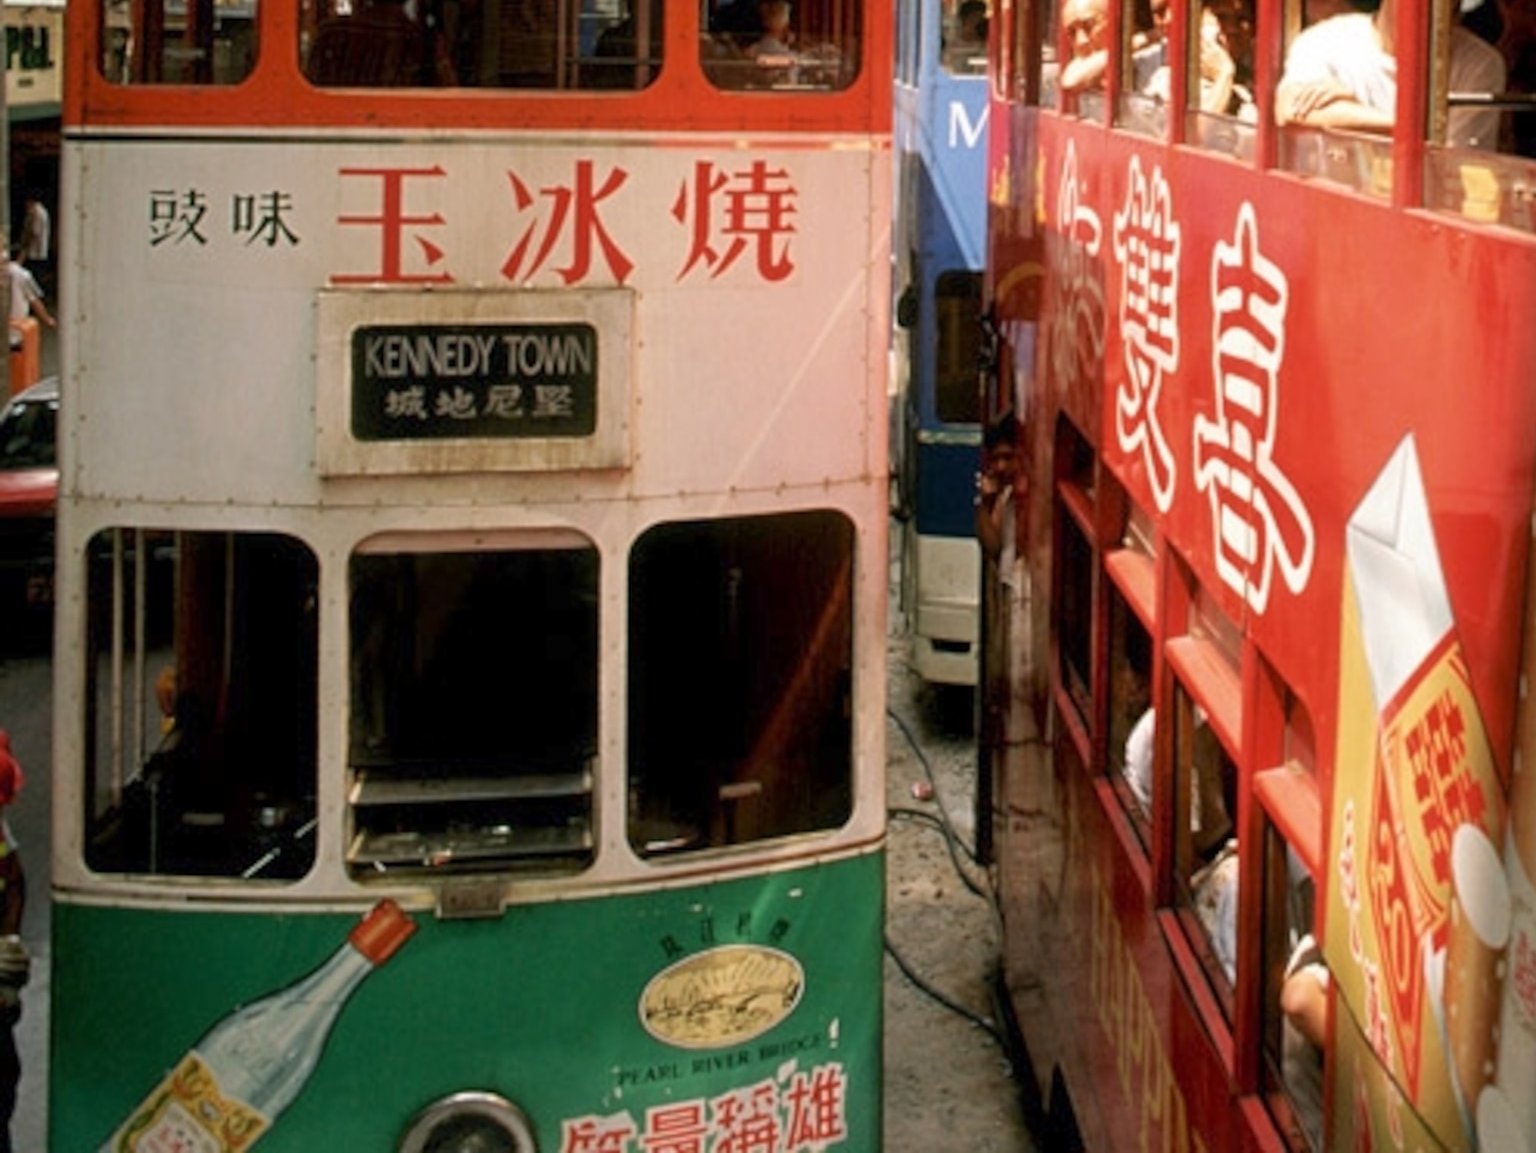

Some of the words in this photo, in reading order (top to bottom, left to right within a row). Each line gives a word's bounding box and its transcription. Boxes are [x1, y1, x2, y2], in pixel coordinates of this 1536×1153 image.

[329, 159, 798, 286] 玉冰燒
[364, 334, 495, 377] KENNEDY
[503, 334, 591, 376] TOWN
[617, 1063, 678, 1086] PEARL
[692, 1049, 750, 1075] RIVER
